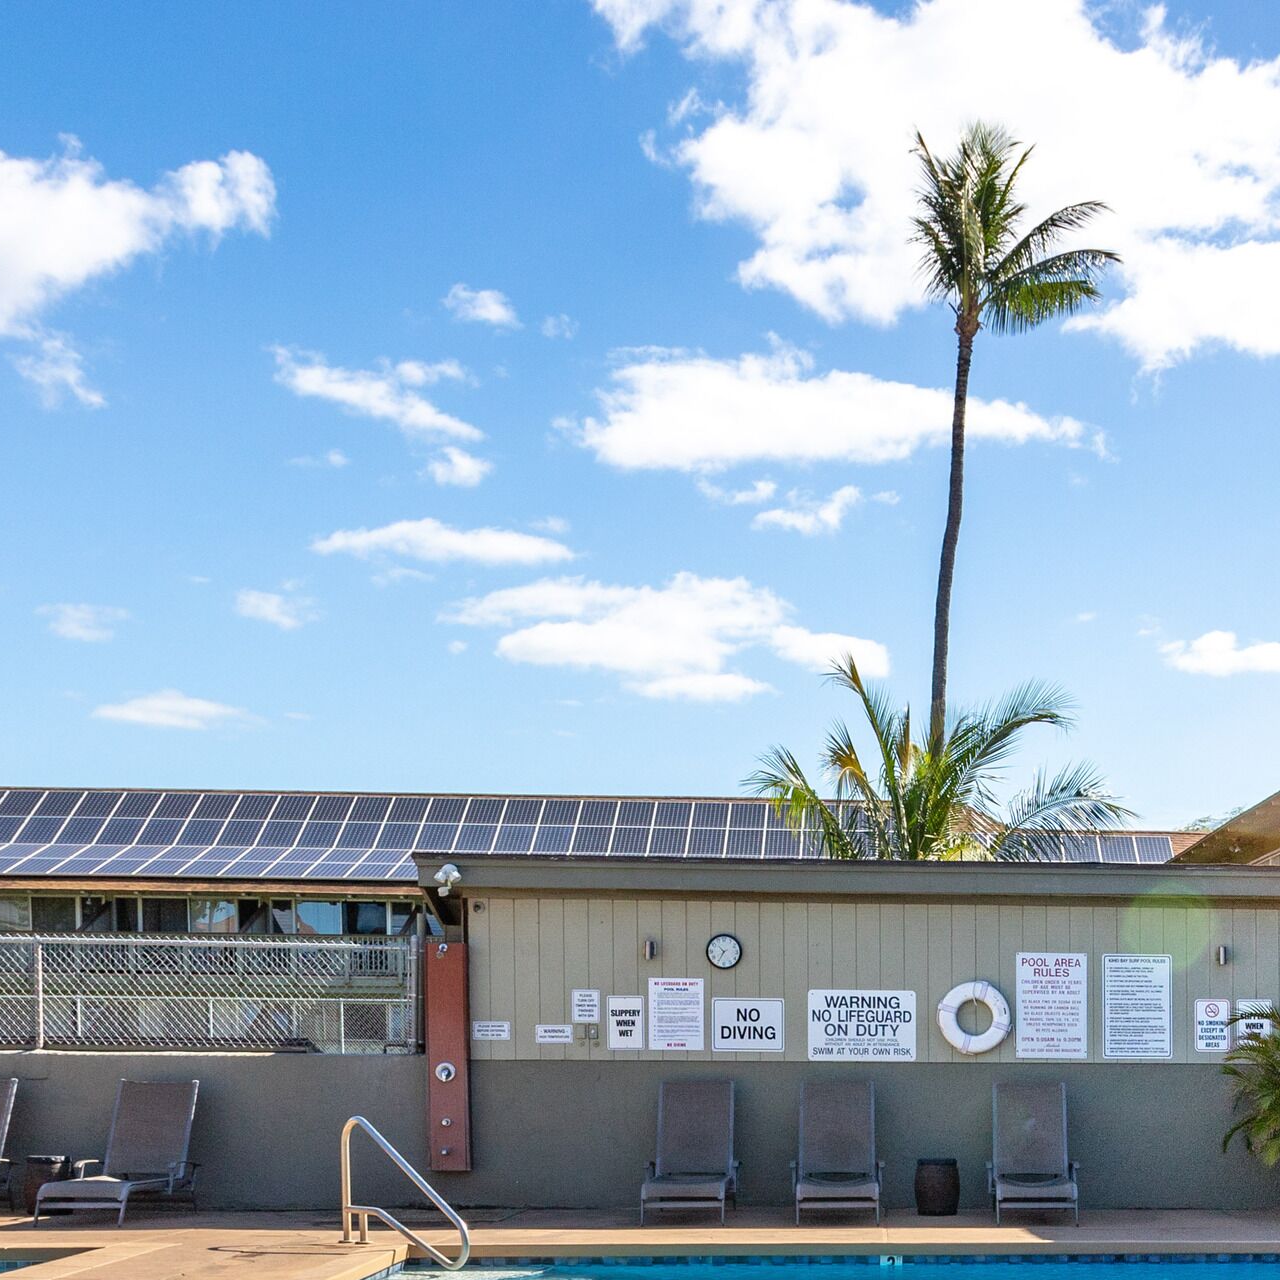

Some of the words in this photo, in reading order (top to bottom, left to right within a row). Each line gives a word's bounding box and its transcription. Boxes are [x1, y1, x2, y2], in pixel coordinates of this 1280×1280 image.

[1021, 958, 1049, 967] POOL
[1054, 958, 1081, 967] AREA
[1033, 968, 1070, 977] RULES
[824, 996, 900, 1009] WARNING
[736, 1008, 761, 1022] NO
[812, 1010, 832, 1023] NO
[838, 1010, 912, 1023] LIFEGUARD
[721, 1026, 776, 1040] DIVING
[824, 1024, 848, 1037] ON
[856, 1024, 900, 1037] DUTY
[813, 1047, 833, 1055] SWIM
[836, 1047, 845, 1055] AT
[848, 1047, 869, 1055] YOUR
[872, 1047, 890, 1055] OWN
[894, 1047, 911, 1055] RISK
